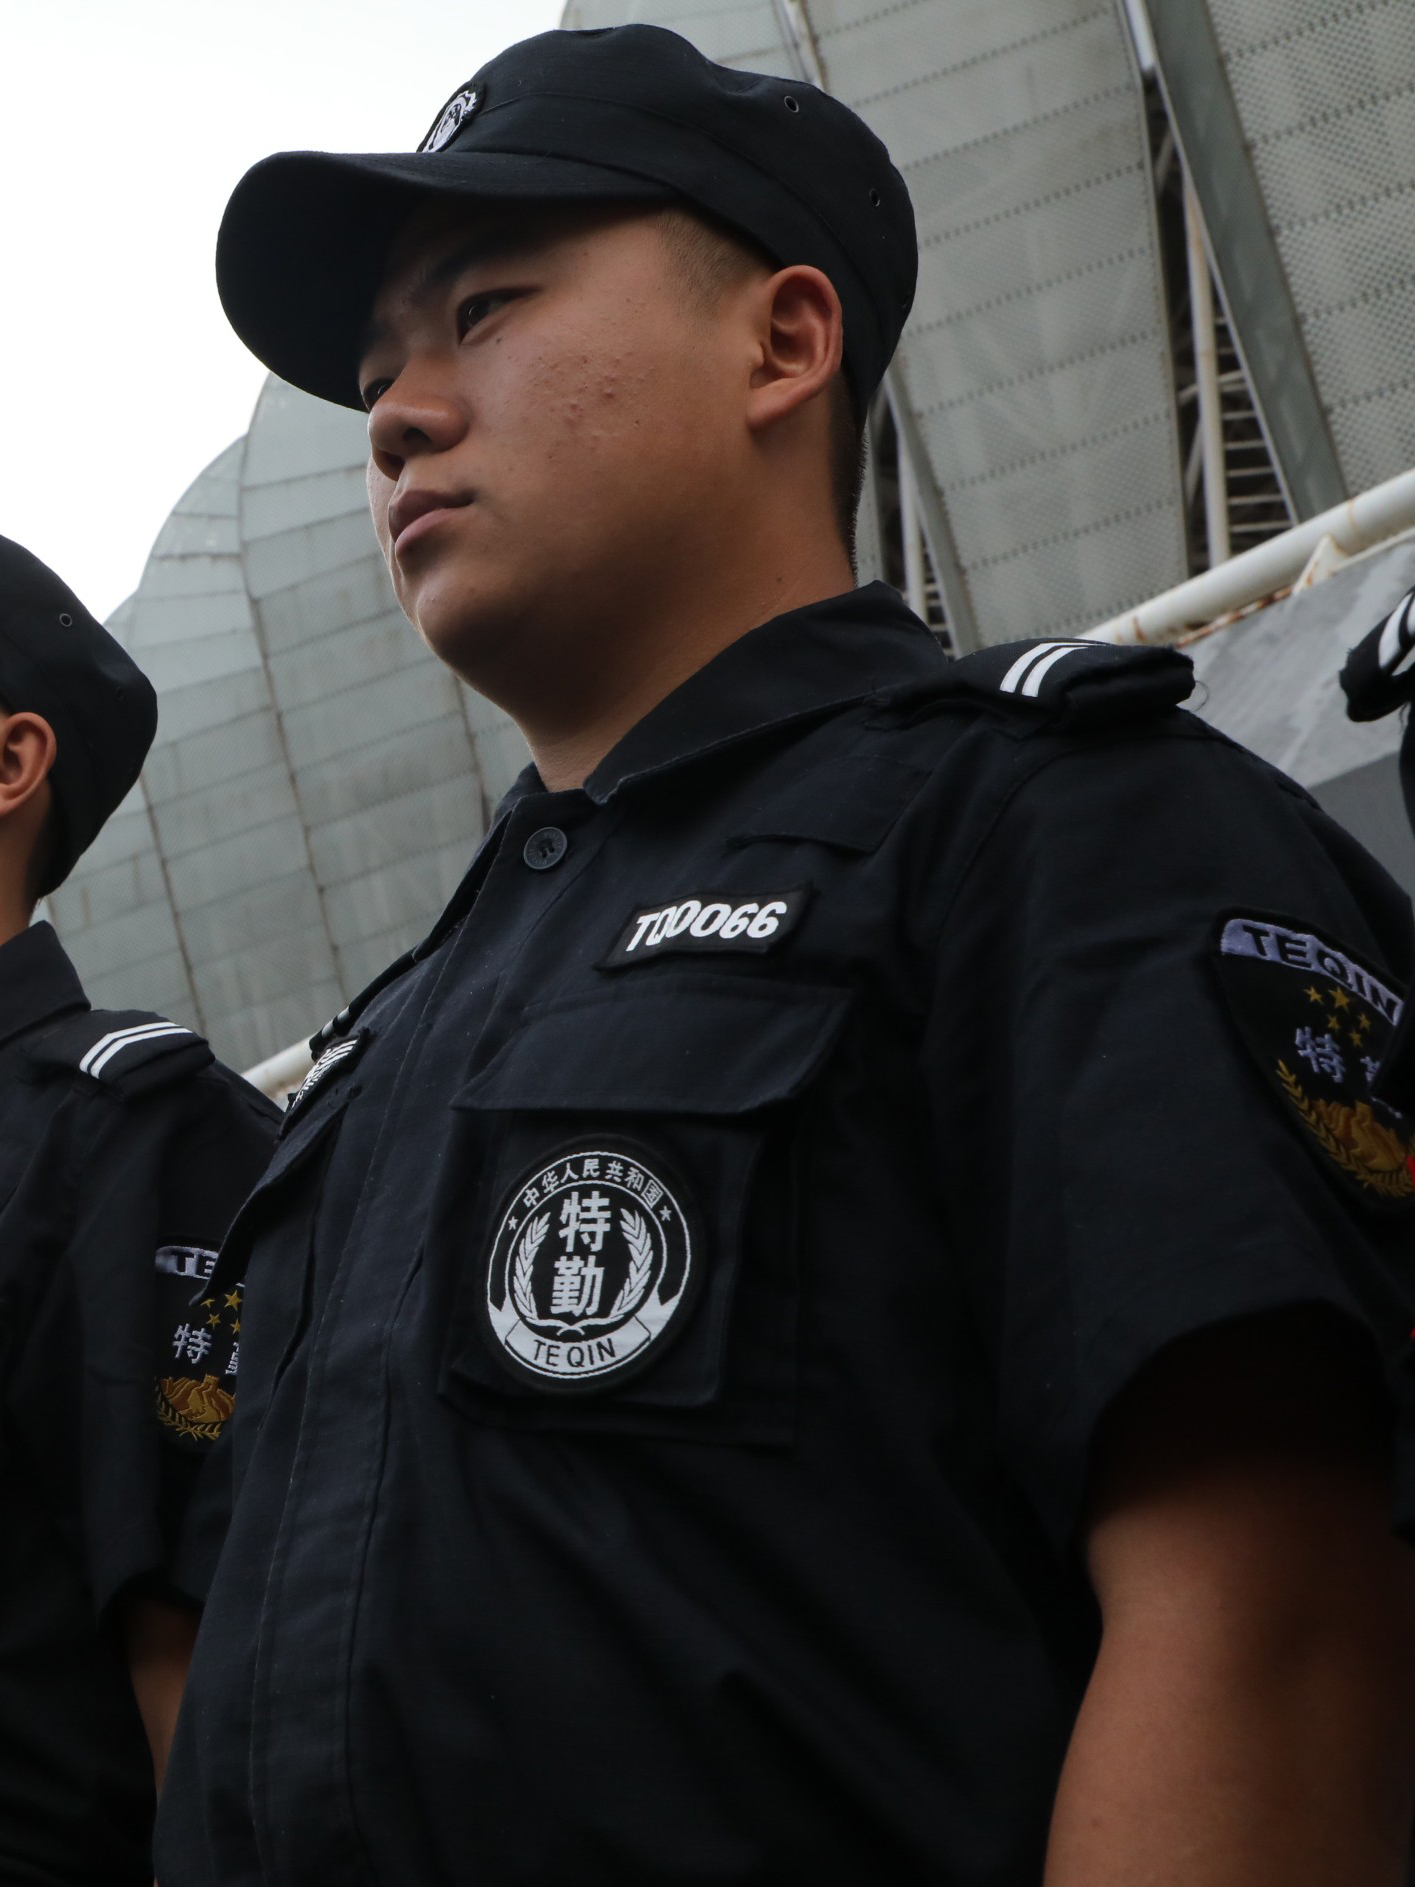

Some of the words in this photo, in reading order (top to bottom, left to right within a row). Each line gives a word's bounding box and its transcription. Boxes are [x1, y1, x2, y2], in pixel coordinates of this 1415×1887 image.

[1242, 924, 1398, 1026] TEQIN
[522, 1158, 664, 1209] 中华人民共和国
[550, 1190, 612, 1317] 特勤
